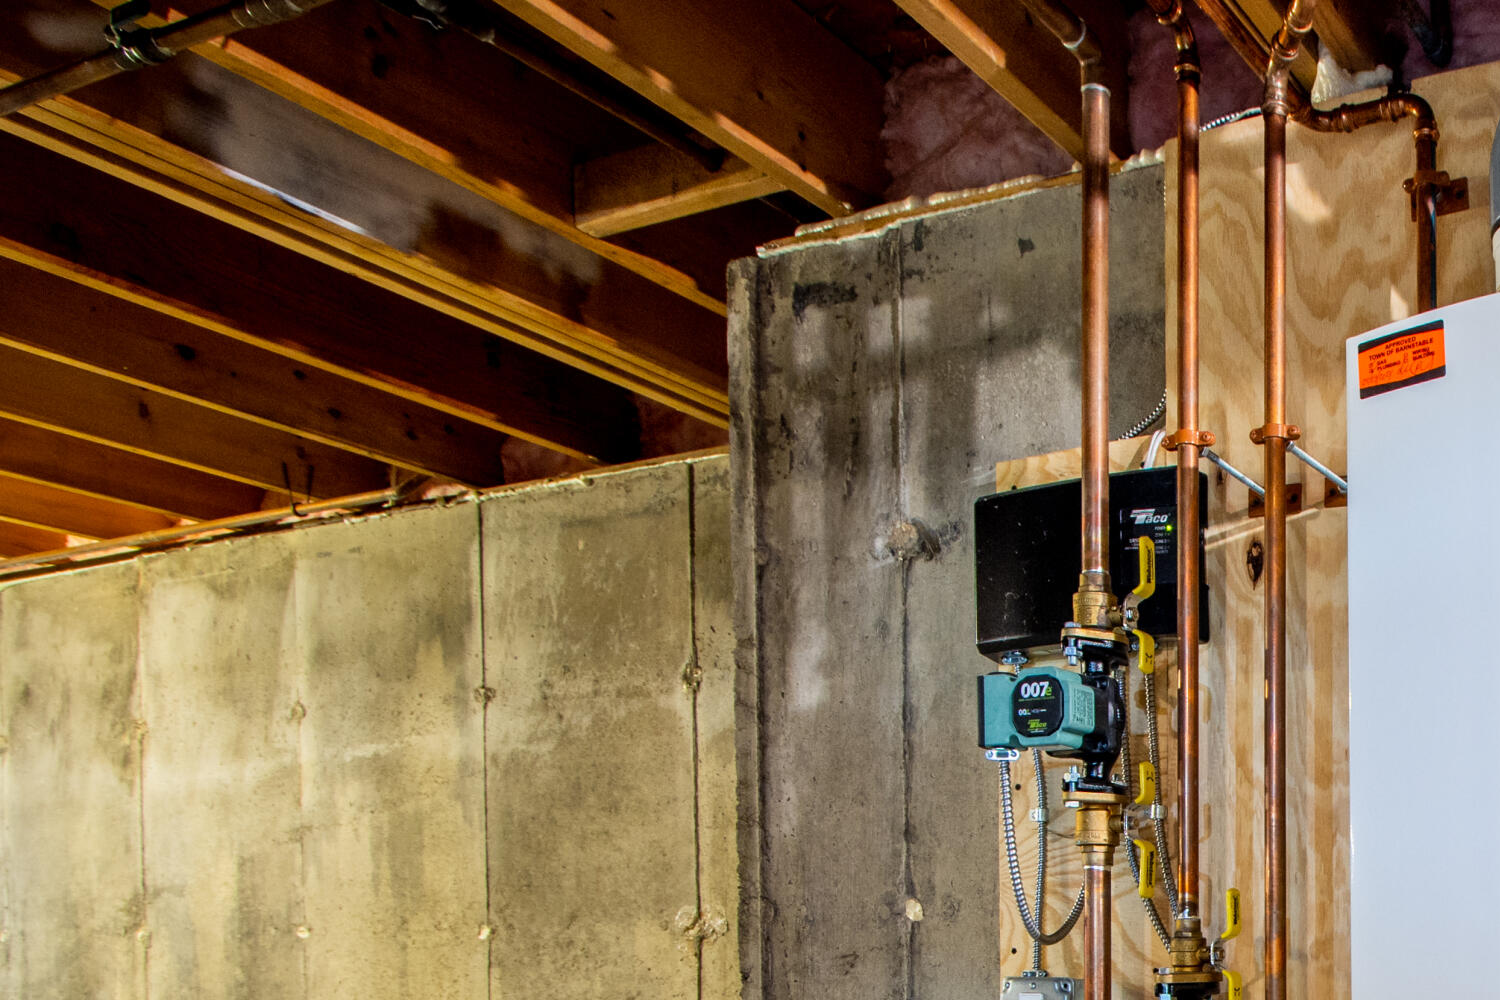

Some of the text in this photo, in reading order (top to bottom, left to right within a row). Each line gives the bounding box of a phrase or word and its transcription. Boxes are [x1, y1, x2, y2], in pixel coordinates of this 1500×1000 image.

[1368, 338, 1434, 360] TOWN OF BARNSTABLE
[1385, 336, 1416, 349] APPROVED
[1130, 508, 1168, 525] Taco
